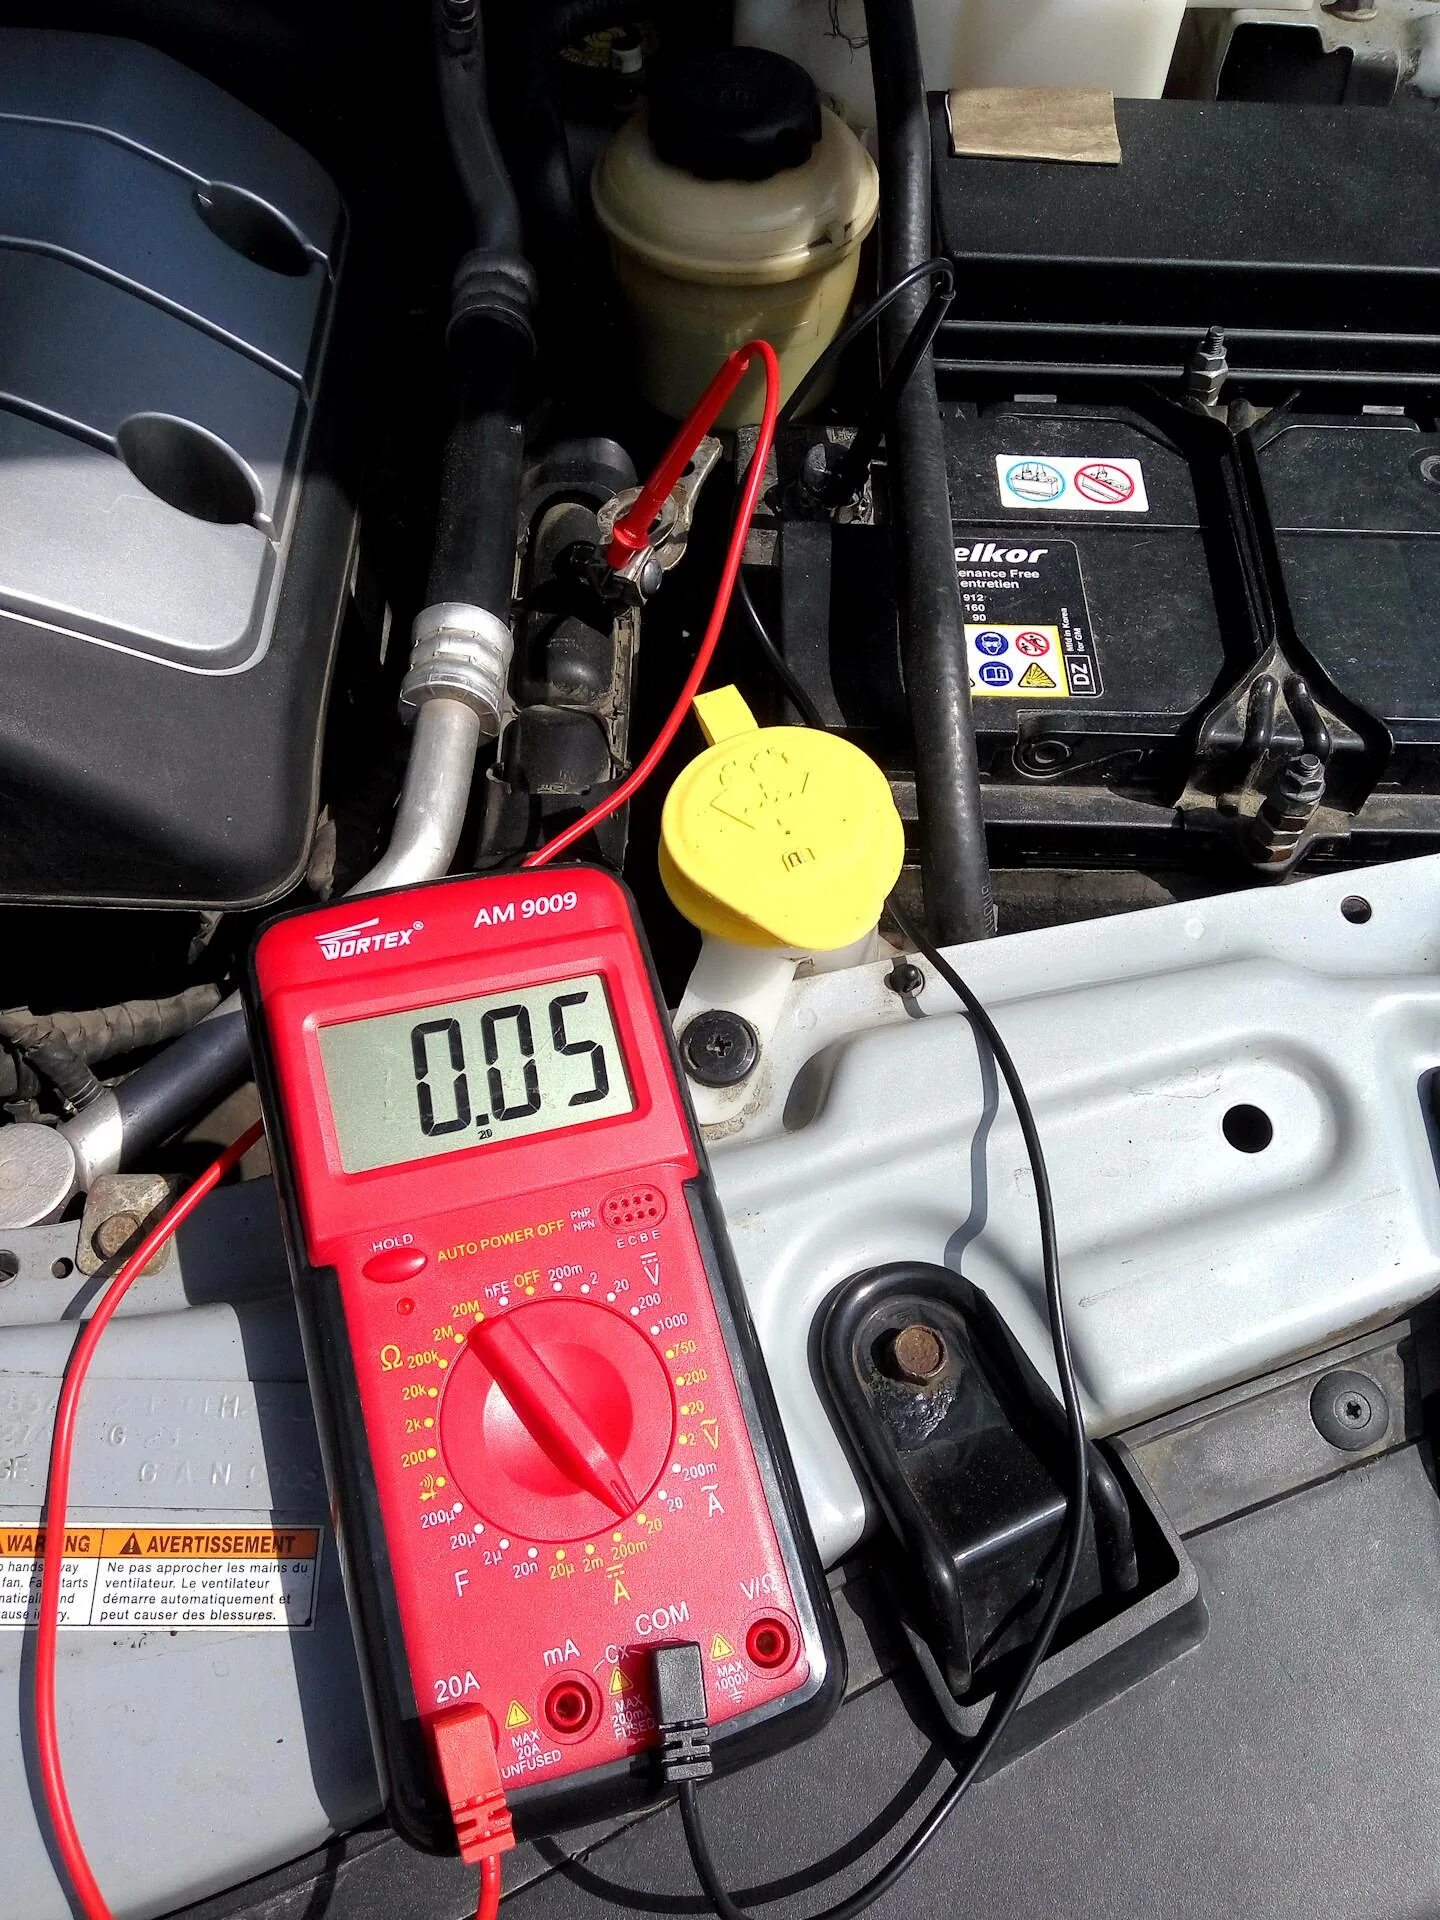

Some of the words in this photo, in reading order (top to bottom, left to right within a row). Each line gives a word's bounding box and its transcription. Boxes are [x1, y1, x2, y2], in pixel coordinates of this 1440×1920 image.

[954, 543, 1048, 563] elkor
[958, 570, 1007, 578] enance
[1010, 569, 1040, 579] Free
[960, 580, 1020, 589] entretien
[963, 594, 984, 602] 912
[964, 604, 986, 612] 160
[972, 614, 987, 622] 90
[1061, 607, 1070, 629] Korea
[1074, 628, 1083, 641] GM
[1071, 663, 1090, 686] DZ
[473, 903, 515, 928] AM
[520, 891, 578, 919] 9009
[410, 991, 610, 1137] 0.05
[570, 1207, 592, 1220] PNP
[573, 1219, 596, 1232] NPN
[372, 1233, 414, 1252] HOLD
[437, 1242, 478, 1263] AUTO
[480, 1227, 535, 1251] POWER
[537, 1219, 566, 1236] OFF
[513, 1269, 541, 1288] OFF
[547, 1264, 584, 1282] 200m
[589, 1271, 599, 1285] 2
[484, 1280, 511, 1299] hFE
[613, 1278, 630, 1294] 20
[451, 1299, 480, 1318] 20M
[637, 1292, 662, 1310] 200
[659, 1312, 689, 1331] 1000
[432, 1324, 454, 1341] 2M
[673, 1340, 697, 1357] 750
[380, 1344, 404, 1372] Ω
[407, 1350, 440, 1369] 200k
[684, 1368, 708, 1386] 200
[401, 1384, 427, 1401] 20k
[688, 1400, 705, 1416] 20
[404, 1417, 422, 1434] 2k
[688, 1432, 697, 1446] 2
[401, 1449, 428, 1468] 200
[682, 1462, 718, 1482] 200m
[667, 1496, 684, 1512] 20
[646, 1517, 664, 1535] 20
[7, 1535, 91, 1553] WARNG
[147, 1535, 296, 1554] AVERTISSEMENT
[611, 1540, 648, 1560] 200m
[107, 1561, 125, 1573] Ne
[129, 1563, 152, 1576] pas
[156, 1562, 223, 1575] approcher
[227, 1562, 245, 1573] les
[249, 1562, 288, 1574] mains
[292, 1562, 308, 1574] du
[512, 1561, 539, 1580] 20n
[583, 1557, 604, 1573] 2m
[2, 1577, 24, 1588] fan.
[29, 1577, 43, 1588] Fa
[61, 1578, 89, 1588] tarts
[105, 1577, 176, 1589] ventilateur.
[181, 1578, 197, 1589] Le
[201, 1577, 270, 1589] ventilateur
[454, 1569, 470, 1598] F
[59, 1592, 76, 1604] nd
[102, 1593, 156, 1604] démarre
[160, 1594, 275, 1607] automatiquement
[279, 1594, 292, 1605] et
[0, 1609, 29, 1620] ause
[100, 1609, 129, 1622] peut
[134, 1611, 178, 1621] causer
[182, 1609, 206, 1621] des
[210, 1609, 276, 1621] blessures.
[635, 1600, 690, 1636] COM
[543, 1638, 581, 1667] mA
[716, 1660, 744, 1678] MAX
[434, 1670, 480, 1704] 20A
[715, 1669, 749, 1692] 1000V
[615, 1694, 642, 1712] MAX
[611, 1706, 653, 1728] 200mA
[511, 1728, 540, 1748] MAX
[615, 1718, 655, 1740] FUSED
[516, 1743, 541, 1760] 20A
[501, 1749, 562, 1780] UNFUSED
